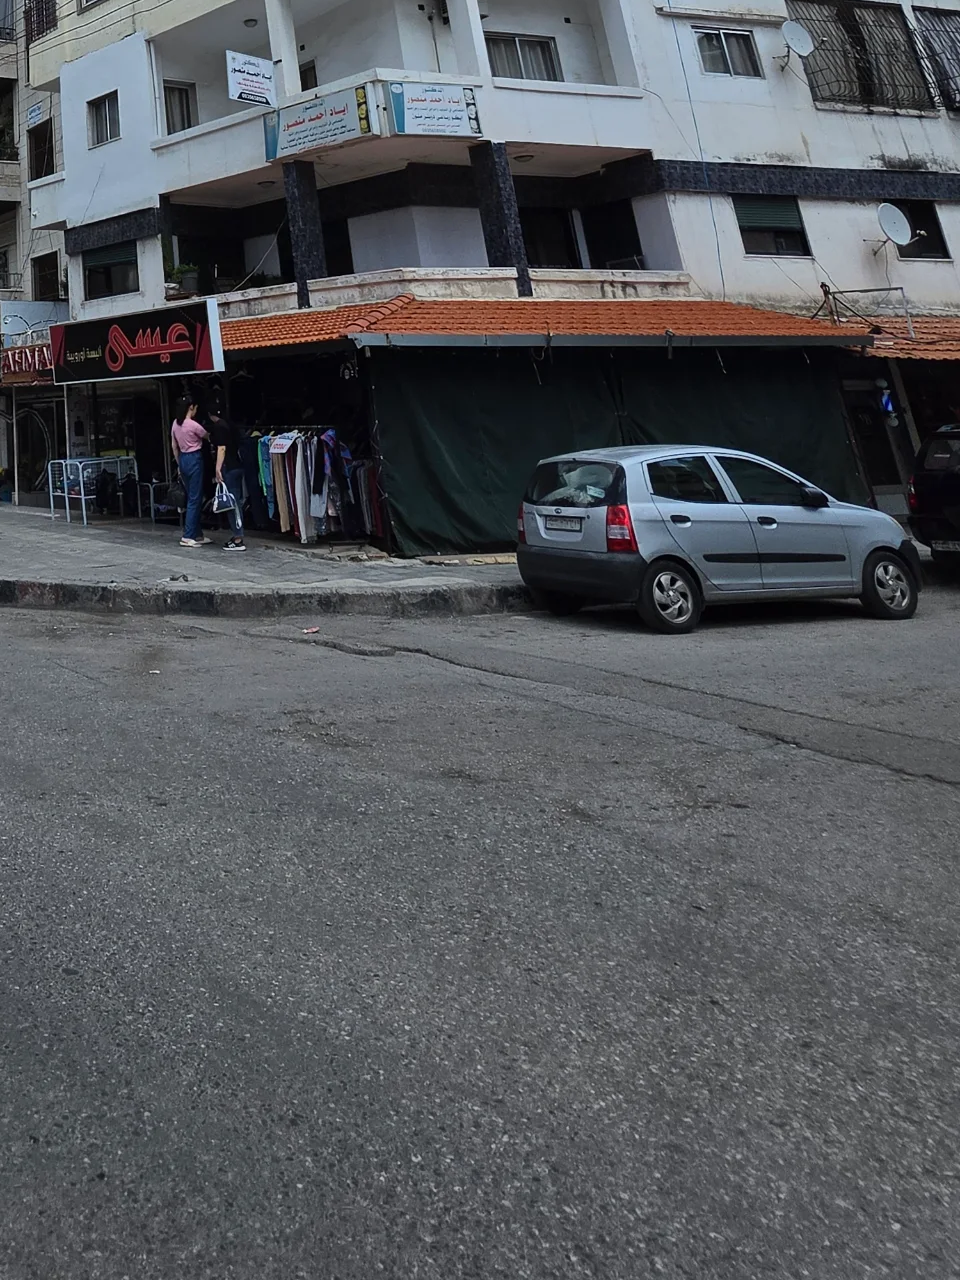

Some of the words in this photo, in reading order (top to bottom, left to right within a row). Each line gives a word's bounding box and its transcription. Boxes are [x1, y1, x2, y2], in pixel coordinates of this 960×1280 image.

[407, 94, 427, 104] منصور
[282, 116, 305, 132] منصور
[104, 322, 194, 372] عيسى
